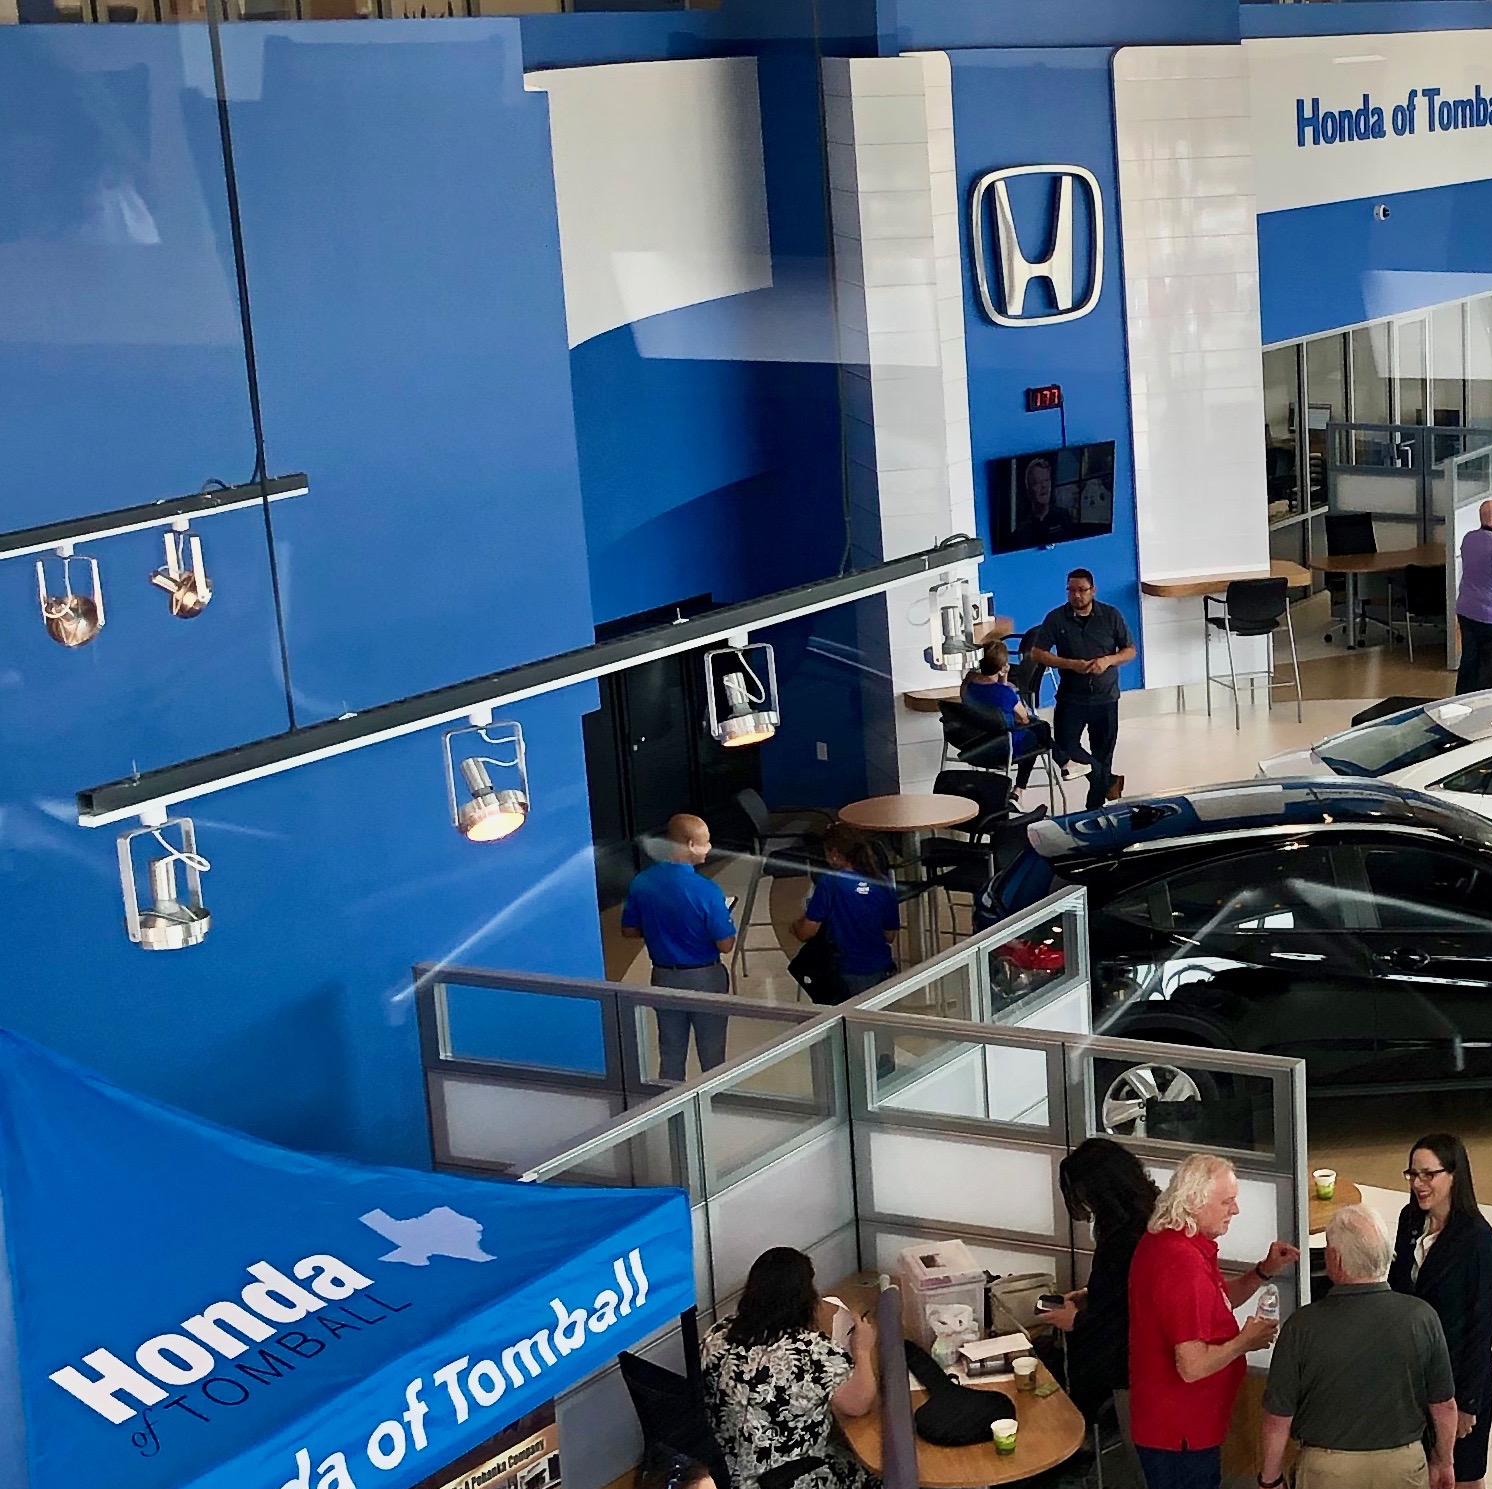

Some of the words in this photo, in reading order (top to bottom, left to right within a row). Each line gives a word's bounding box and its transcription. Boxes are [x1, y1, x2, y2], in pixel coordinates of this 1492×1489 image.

[1296, 93, 1386, 147] Honda
[1392, 88, 1417, 136] of
[49, 1254, 375, 1424] Honda
[131, 1407, 161, 1457] of
[163, 1293, 412, 1422] TOMBALL
[367, 1377, 428, 1470] of
[434, 1247, 650, 1425] Tomball
[507, 1438, 545, 1470] Company
